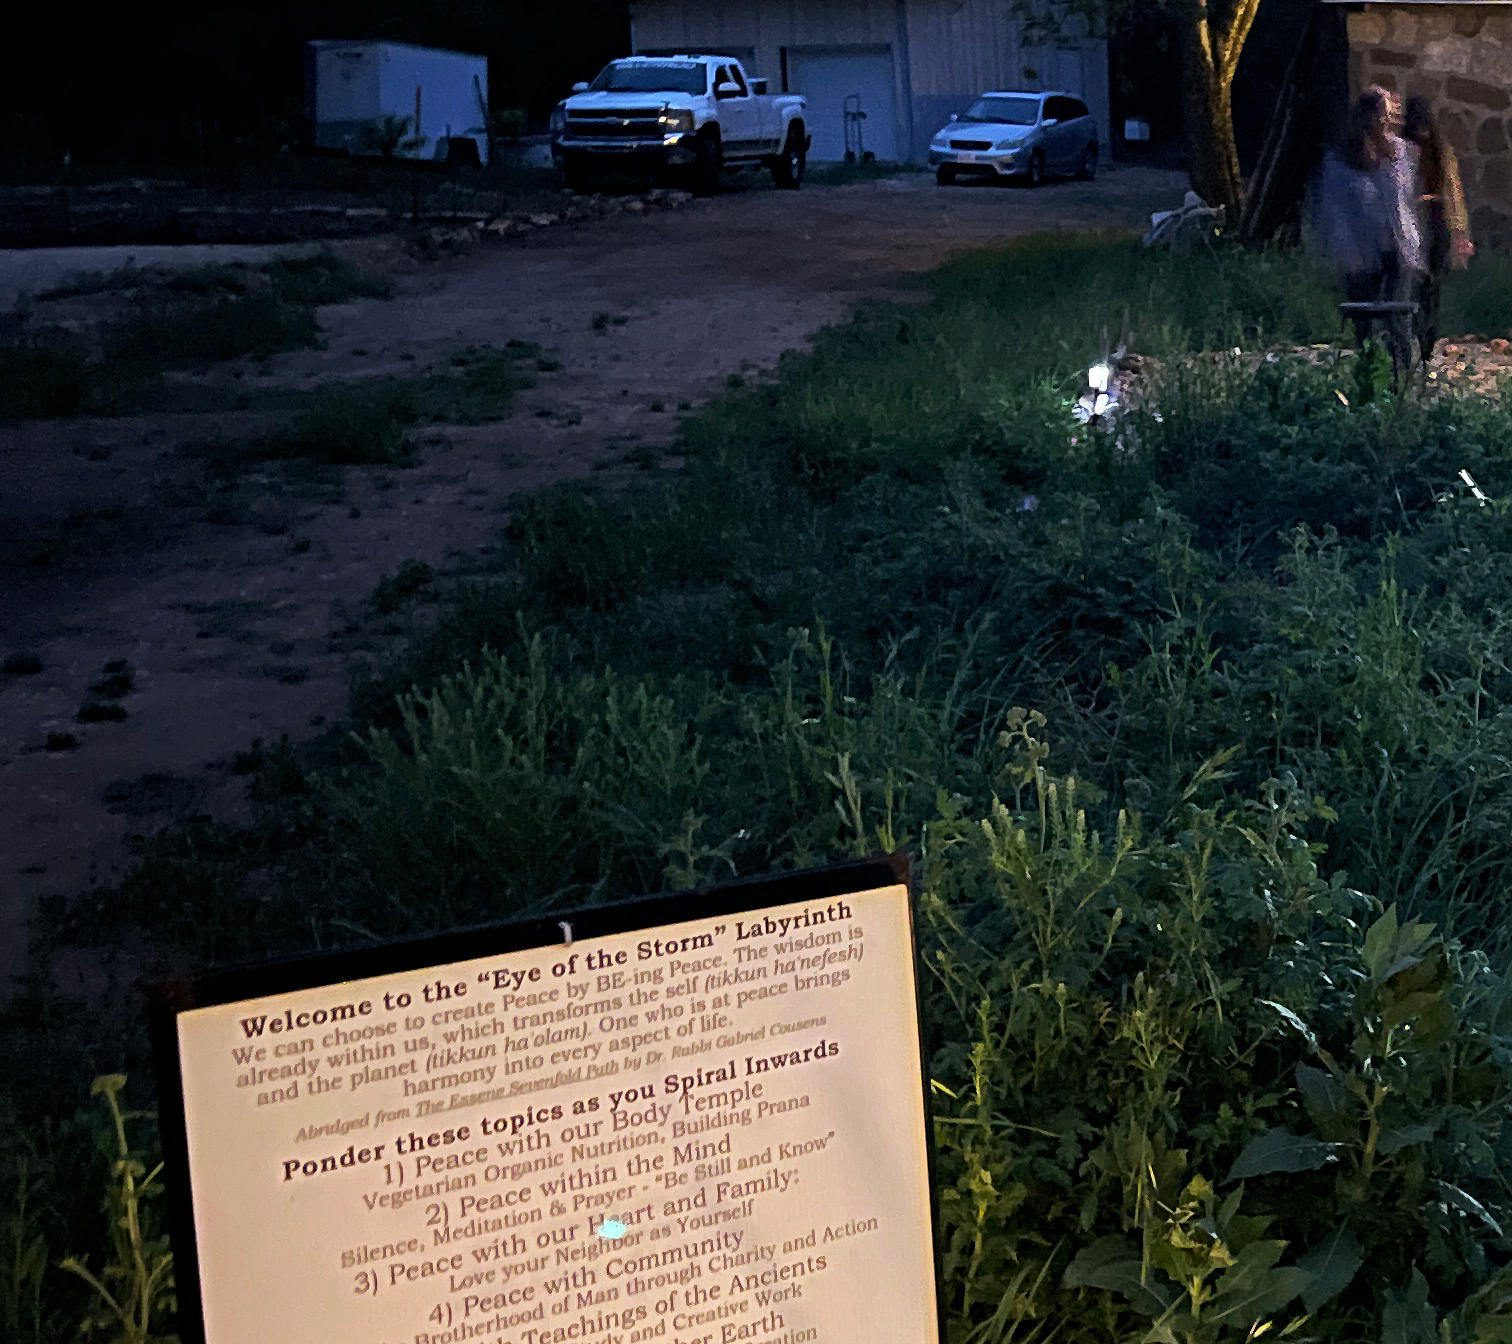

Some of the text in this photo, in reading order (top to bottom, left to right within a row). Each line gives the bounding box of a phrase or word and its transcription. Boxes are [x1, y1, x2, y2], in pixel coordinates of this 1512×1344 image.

[231, 926, 864, 1066] We can choose to create Peace by BE-ing Peace. The wisdom is
[240, 1000, 372, 1039] Welcome
[383, 991, 412, 1011] to
[422, 980, 467, 1003] the
[551, 953, 579, 978] of
[585, 948, 628, 971] the
[735, 901, 853, 941] Labyrinth
[236, 1056, 320, 1089] already
[326, 1041, 396, 1069] within
[403, 1036, 437, 1054] us,
[442, 1017, 505, 1045] which
[512, 997, 623, 1031] transforms
[628, 988, 659, 1007] the
[665, 976, 699, 999] self
[704, 966, 768, 995] (tikkun
[257, 1081, 299, 1107] and
[307, 1076, 343, 1096] the
[350, 1058, 418, 1092] planet
[425, 1043, 497, 1075] (tikkun
[598, 1014, 639, 1033] One
[644, 1004, 685, 1024] who
[690, 998, 707, 1015] is
[711, 992, 731, 1010] at
[736, 982, 788, 1009] peace
[794, 969, 851, 992] brings
[403, 1013, 733, 1097] harmony into every aspect of life.
[282, 1039, 840, 1182] Ponder these topics as you Spiral Inwards
[362, 1095, 810, 1211] Vegetarian Organic Nutrition, Building Prana
[383, 1081, 763, 1187] 1) Peace with our Body Temple
[341, 1238, 425, 1269] Silence,
[433, 1207, 543, 1247] Meditation
[549, 1199, 567, 1218] &
[572, 1184, 636, 1213] Prayer
[694, 1156, 732, 1182] Still
[737, 1146, 772, 1171] and
[354, 1270, 378, 1296] 3)
[390, 1254, 463, 1286] Peace
[471, 1235, 527, 1264] with
[536, 1224, 580, 1249] our
[663, 1188, 707, 1217] and
[716, 1168, 799, 1205] Family:
[425, 1133, 731, 1227] 2) Peace within the Mind
[428, 1229, 744, 1328] 4) Peace with Community
[449, 1269, 496, 1294] Love
[501, 1255, 550, 1285] your
[649, 1224, 672, 1241] as
[676, 1199, 754, 1234] Yourself
[551, 1294, 571, 1315] of
[576, 1287, 619, 1310] Man
[626, 1261, 702, 1297] through
[708, 1244, 776, 1274] Charity
[782, 1229, 817, 1255] and
[822, 1217, 879, 1245] Action
[654, 1291, 678, 1315] of
[684, 1285, 721, 1307] the
[728, 1255, 827, 1296] Ancients
[629, 1318, 666, 1344] and
[672, 1299, 749, 1332] Creative
[754, 1282, 802, 1308] Work
[721, 1312, 785, 1344] Earth
